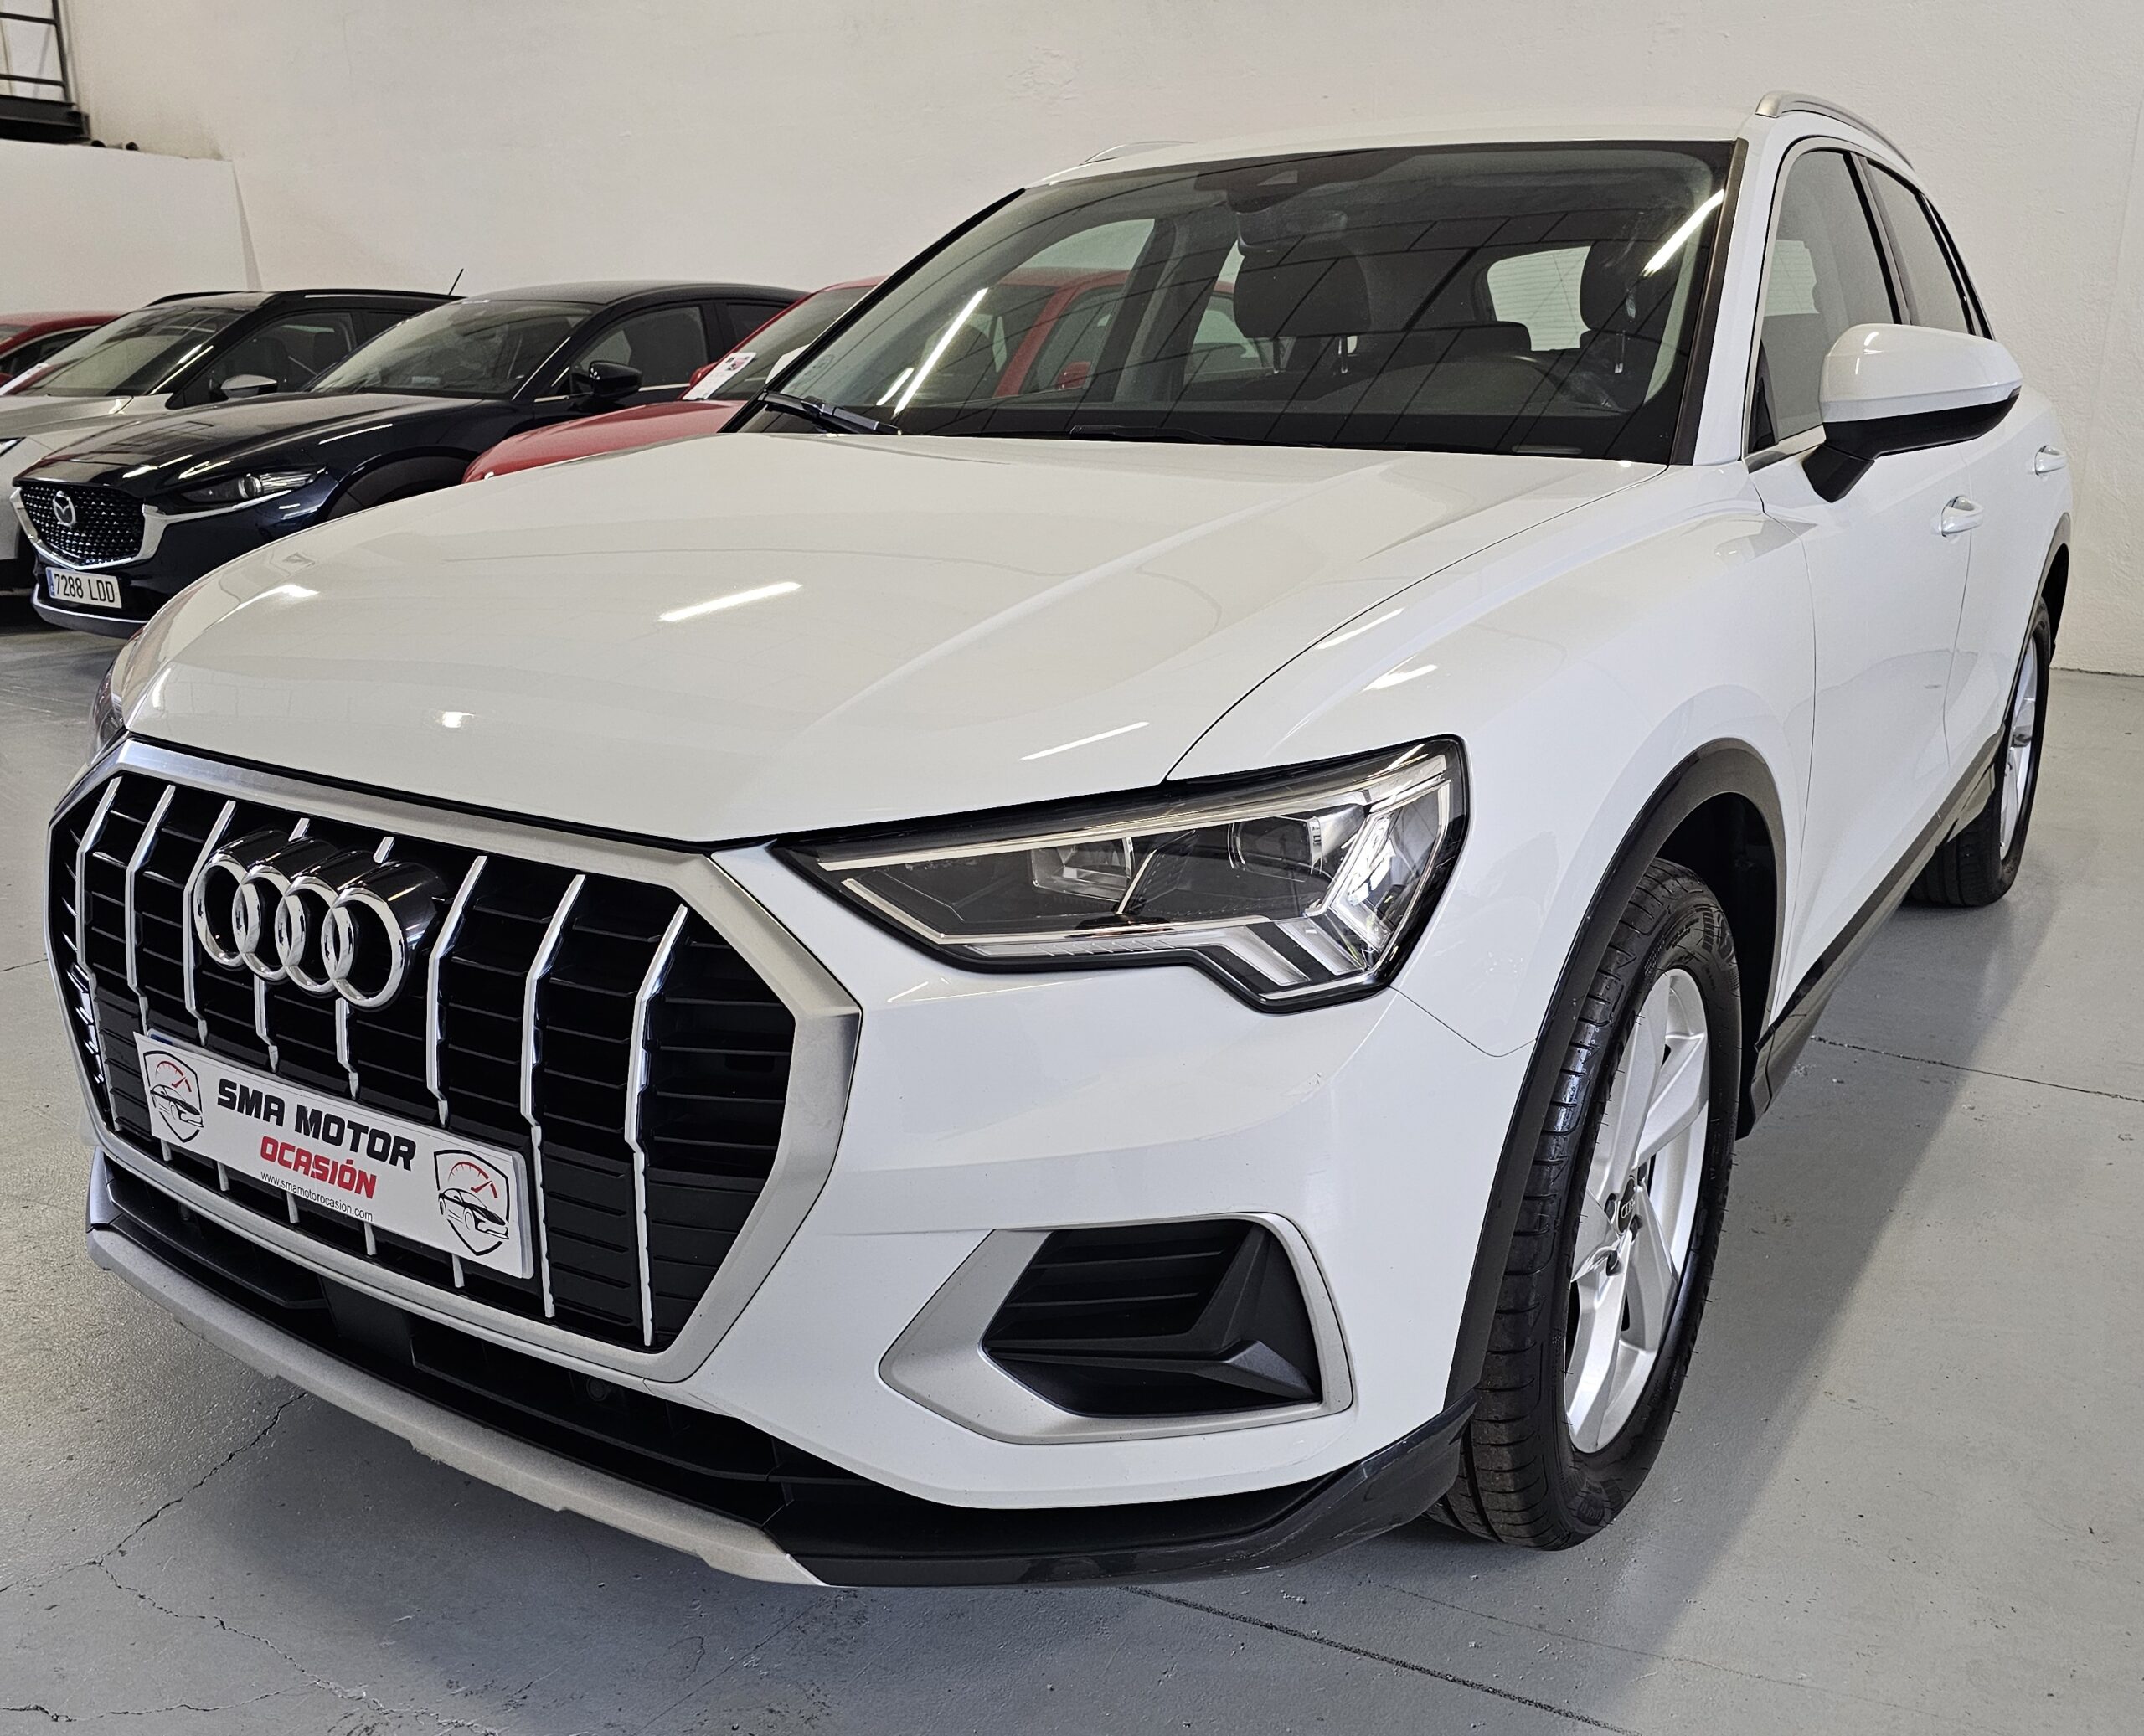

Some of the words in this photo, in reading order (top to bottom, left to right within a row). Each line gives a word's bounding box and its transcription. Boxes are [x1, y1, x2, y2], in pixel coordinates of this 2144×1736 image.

[54, 574, 84, 598] 7288
[88, 580, 116, 603] LDD
[217, 1078, 285, 1126] SMA
[295, 1104, 416, 1171] MOTOR
[260, 1136, 377, 1199] OCASIÓN
[260, 1172, 373, 1222] www.smamotorocasion.com
